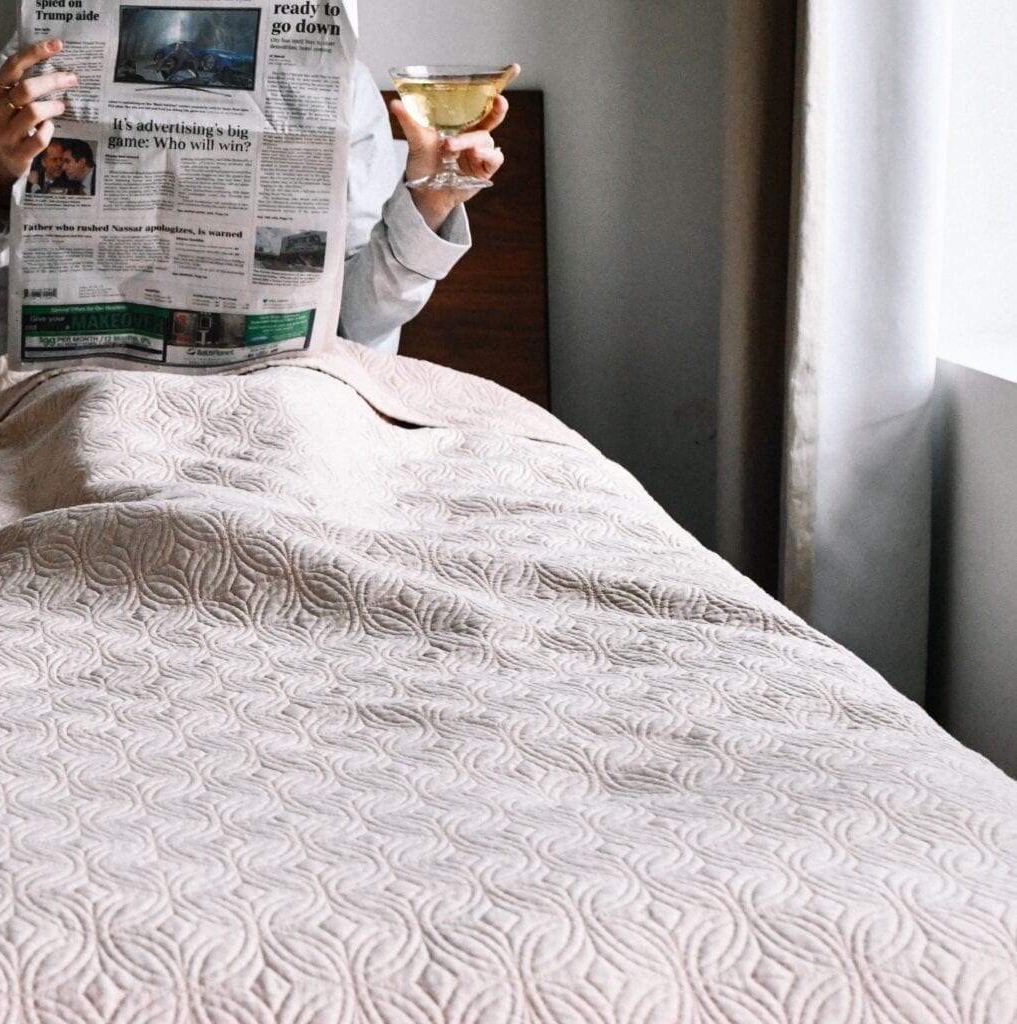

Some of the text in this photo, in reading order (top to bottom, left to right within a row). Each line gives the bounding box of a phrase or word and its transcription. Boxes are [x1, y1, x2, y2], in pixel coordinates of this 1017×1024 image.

[69, 0, 82, 8] on
[274, 1, 340, 18] ready to
[36, 10, 100, 23] Trump aide
[271, 19, 340, 36] go down
[113, 117, 249, 140] It's advertising's big
[108, 136, 252, 152] game: Who will win?
[23, 224, 56, 232] Father
[59, 224, 74, 232] who
[145, 225, 196, 237] apologizes,
[198, 228, 207, 236] is
[208, 229, 243, 239] warned
